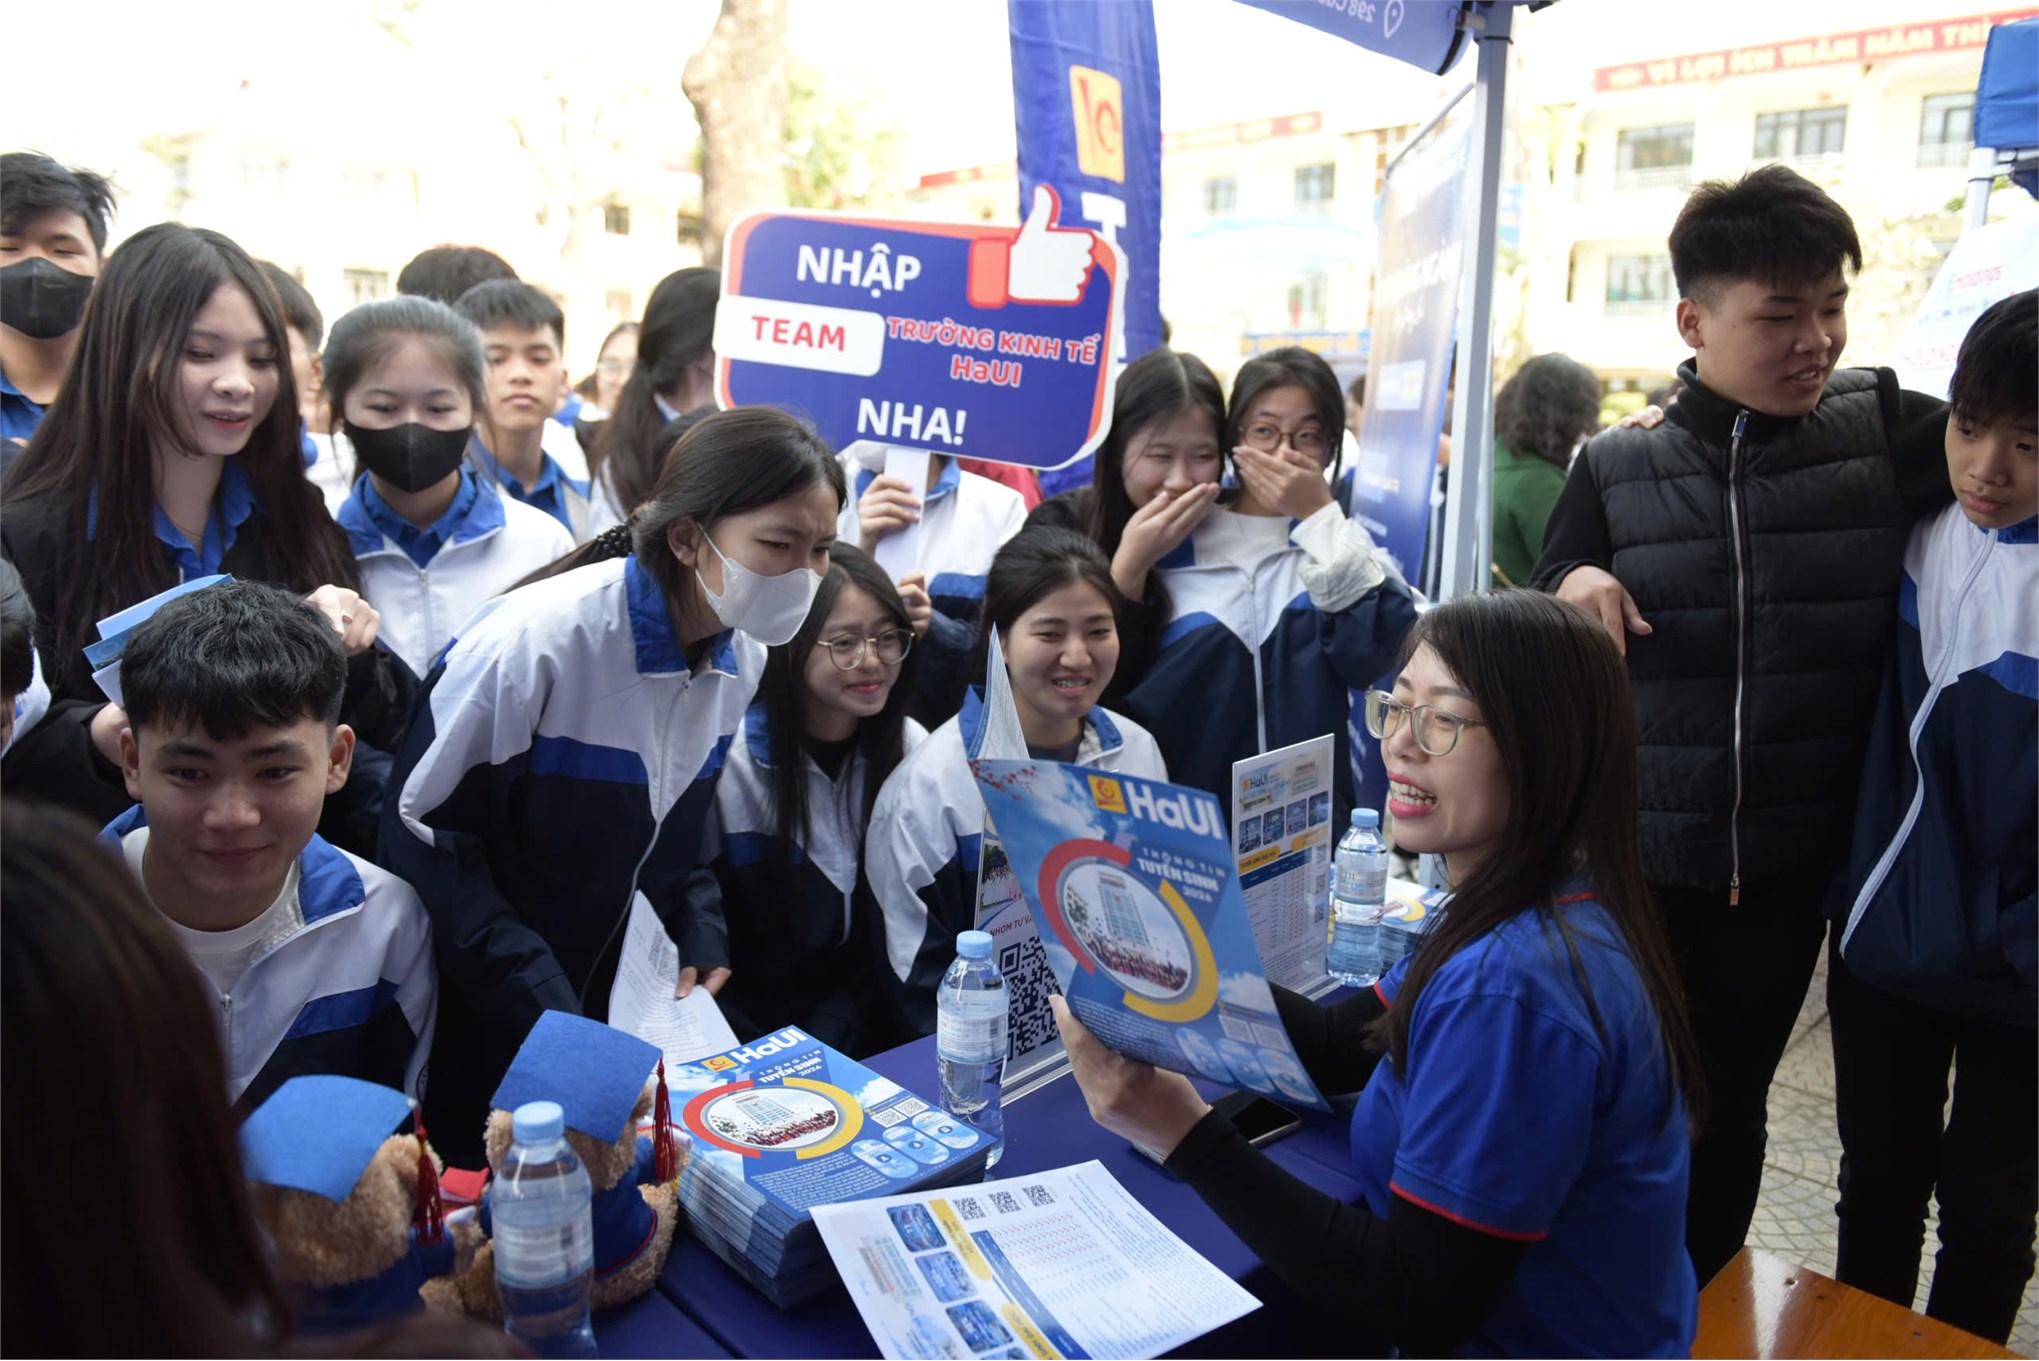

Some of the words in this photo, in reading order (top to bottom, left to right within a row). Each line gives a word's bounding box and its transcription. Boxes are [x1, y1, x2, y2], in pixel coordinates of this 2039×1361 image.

[797, 242, 921, 298] NHẬP
[751, 316, 846, 352] TEAM
[887, 317, 993, 350] TRƯỜNG
[999, 332, 1060, 361] KINH
[1066, 333, 1102, 365] TẾ
[951, 356, 1022, 387] HaUI
[857, 398, 967, 446] NHA!
[1124, 781, 1222, 840] HaUI
[729, 1028, 809, 1064] HaUI
[759, 1059, 800, 1076] THÔNG
[802, 1049, 821, 1060] TIN
